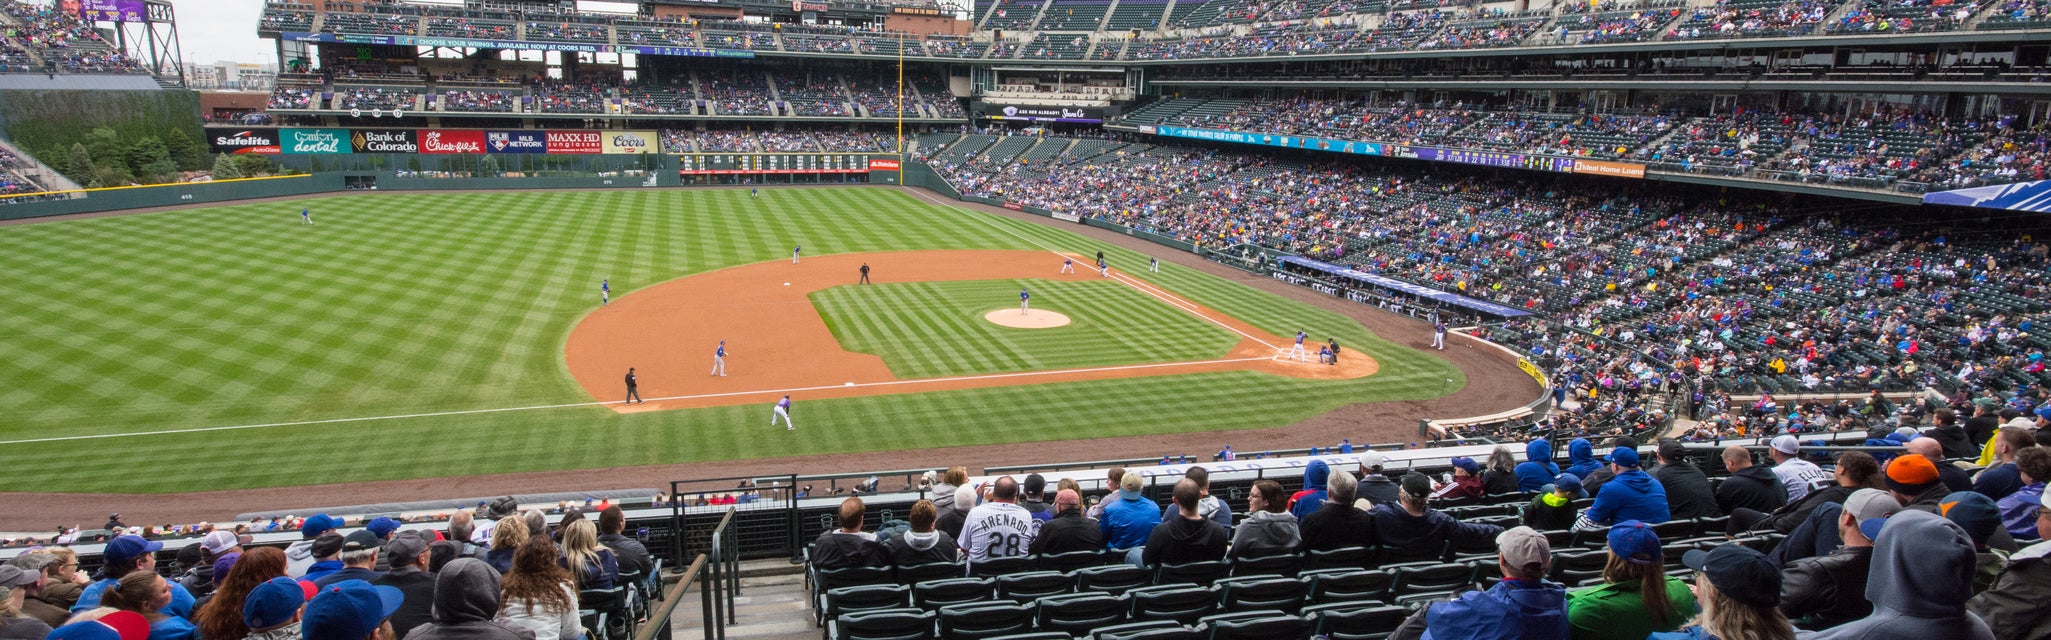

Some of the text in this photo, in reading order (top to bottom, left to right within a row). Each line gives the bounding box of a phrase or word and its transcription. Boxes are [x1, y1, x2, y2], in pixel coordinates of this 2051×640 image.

[217, 136, 270, 145] Safelite
[294, 130, 334, 141] Comfort
[366, 132, 406, 141] Bank of
[488, 132, 509, 140] MLB
[548, 134, 600, 142] MAXX HD
[613, 136, 645, 146] Coors
[294, 138, 339, 152] dental
[368, 141, 417, 151] Colorado
[426, 134, 480, 153] Chick-fil-A
[1583, 163, 1644, 175] Ideal Home Loans
[1798, 470, 1824, 481] ELLIS
[980, 514, 1028, 536] ARENADO
[988, 532, 1019, 556] 28
